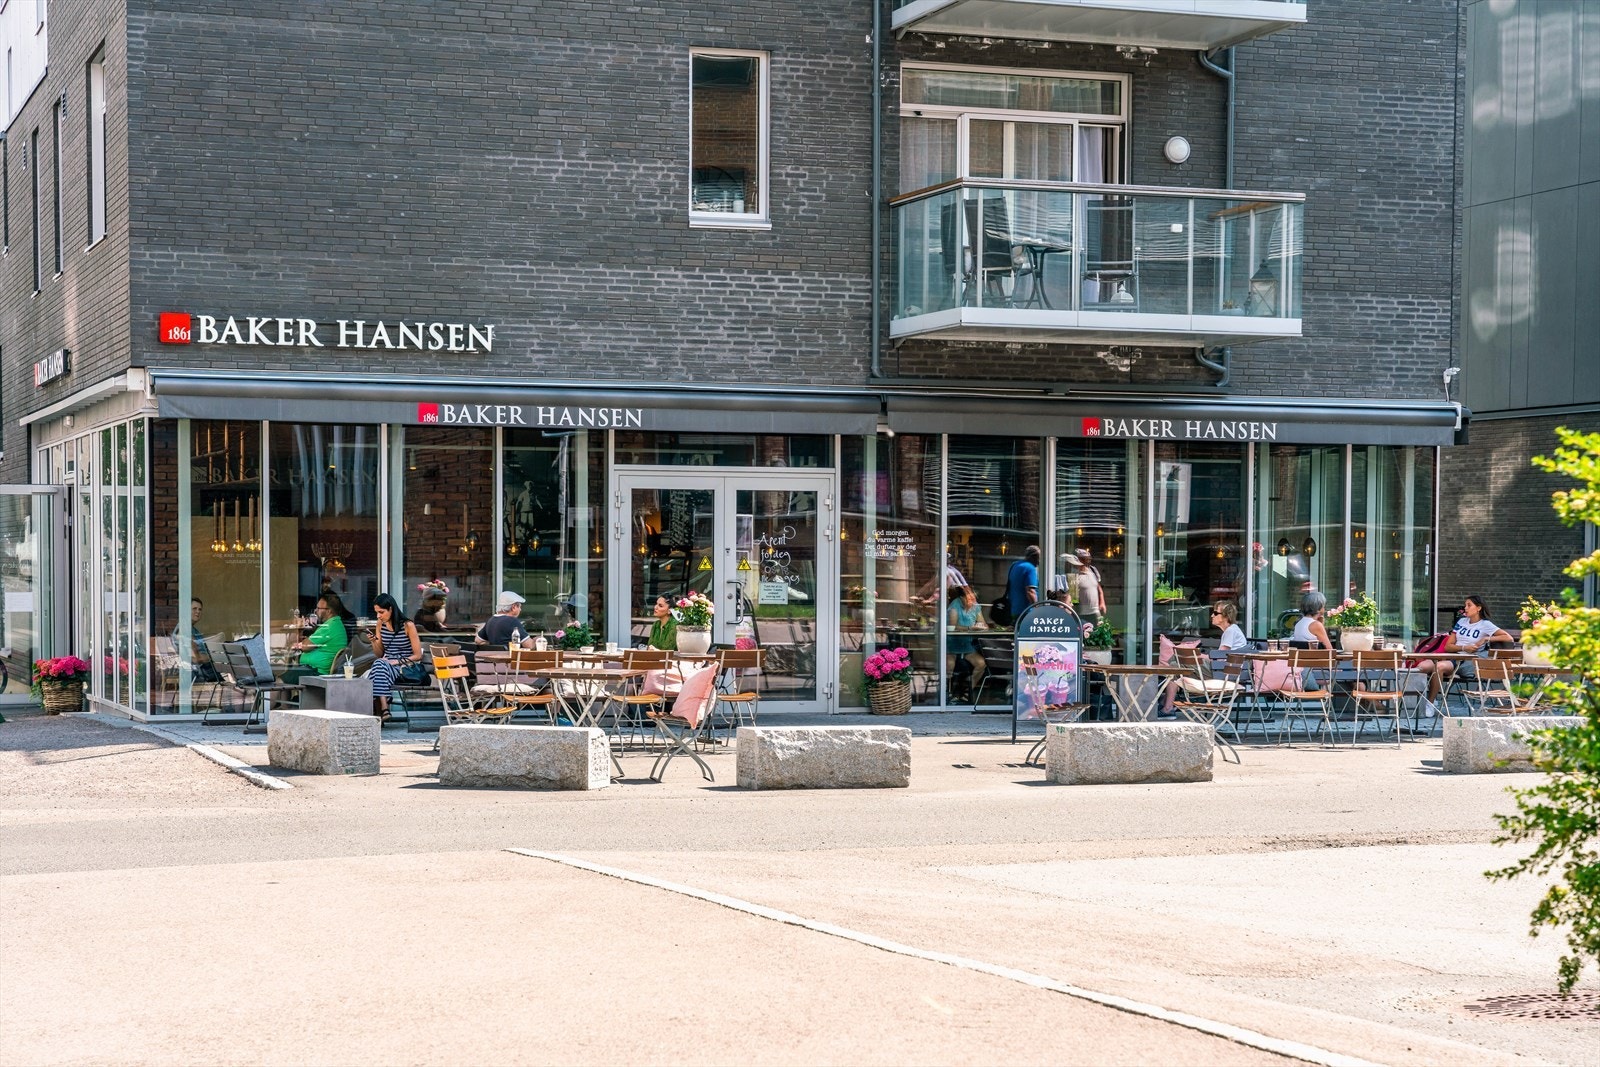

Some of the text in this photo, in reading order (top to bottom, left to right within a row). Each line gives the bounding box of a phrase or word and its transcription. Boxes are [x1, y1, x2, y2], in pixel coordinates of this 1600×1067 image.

[168, 315, 495, 352] 1861 BAKER HANSEN
[423, 404, 643, 428] 1861 BAKER HANSEN
[1086, 418, 1278, 441] 1861 BAKER HANSEN
[905, 543, 917, 551] deg
[1020, 661, 1074, 671] soothie
